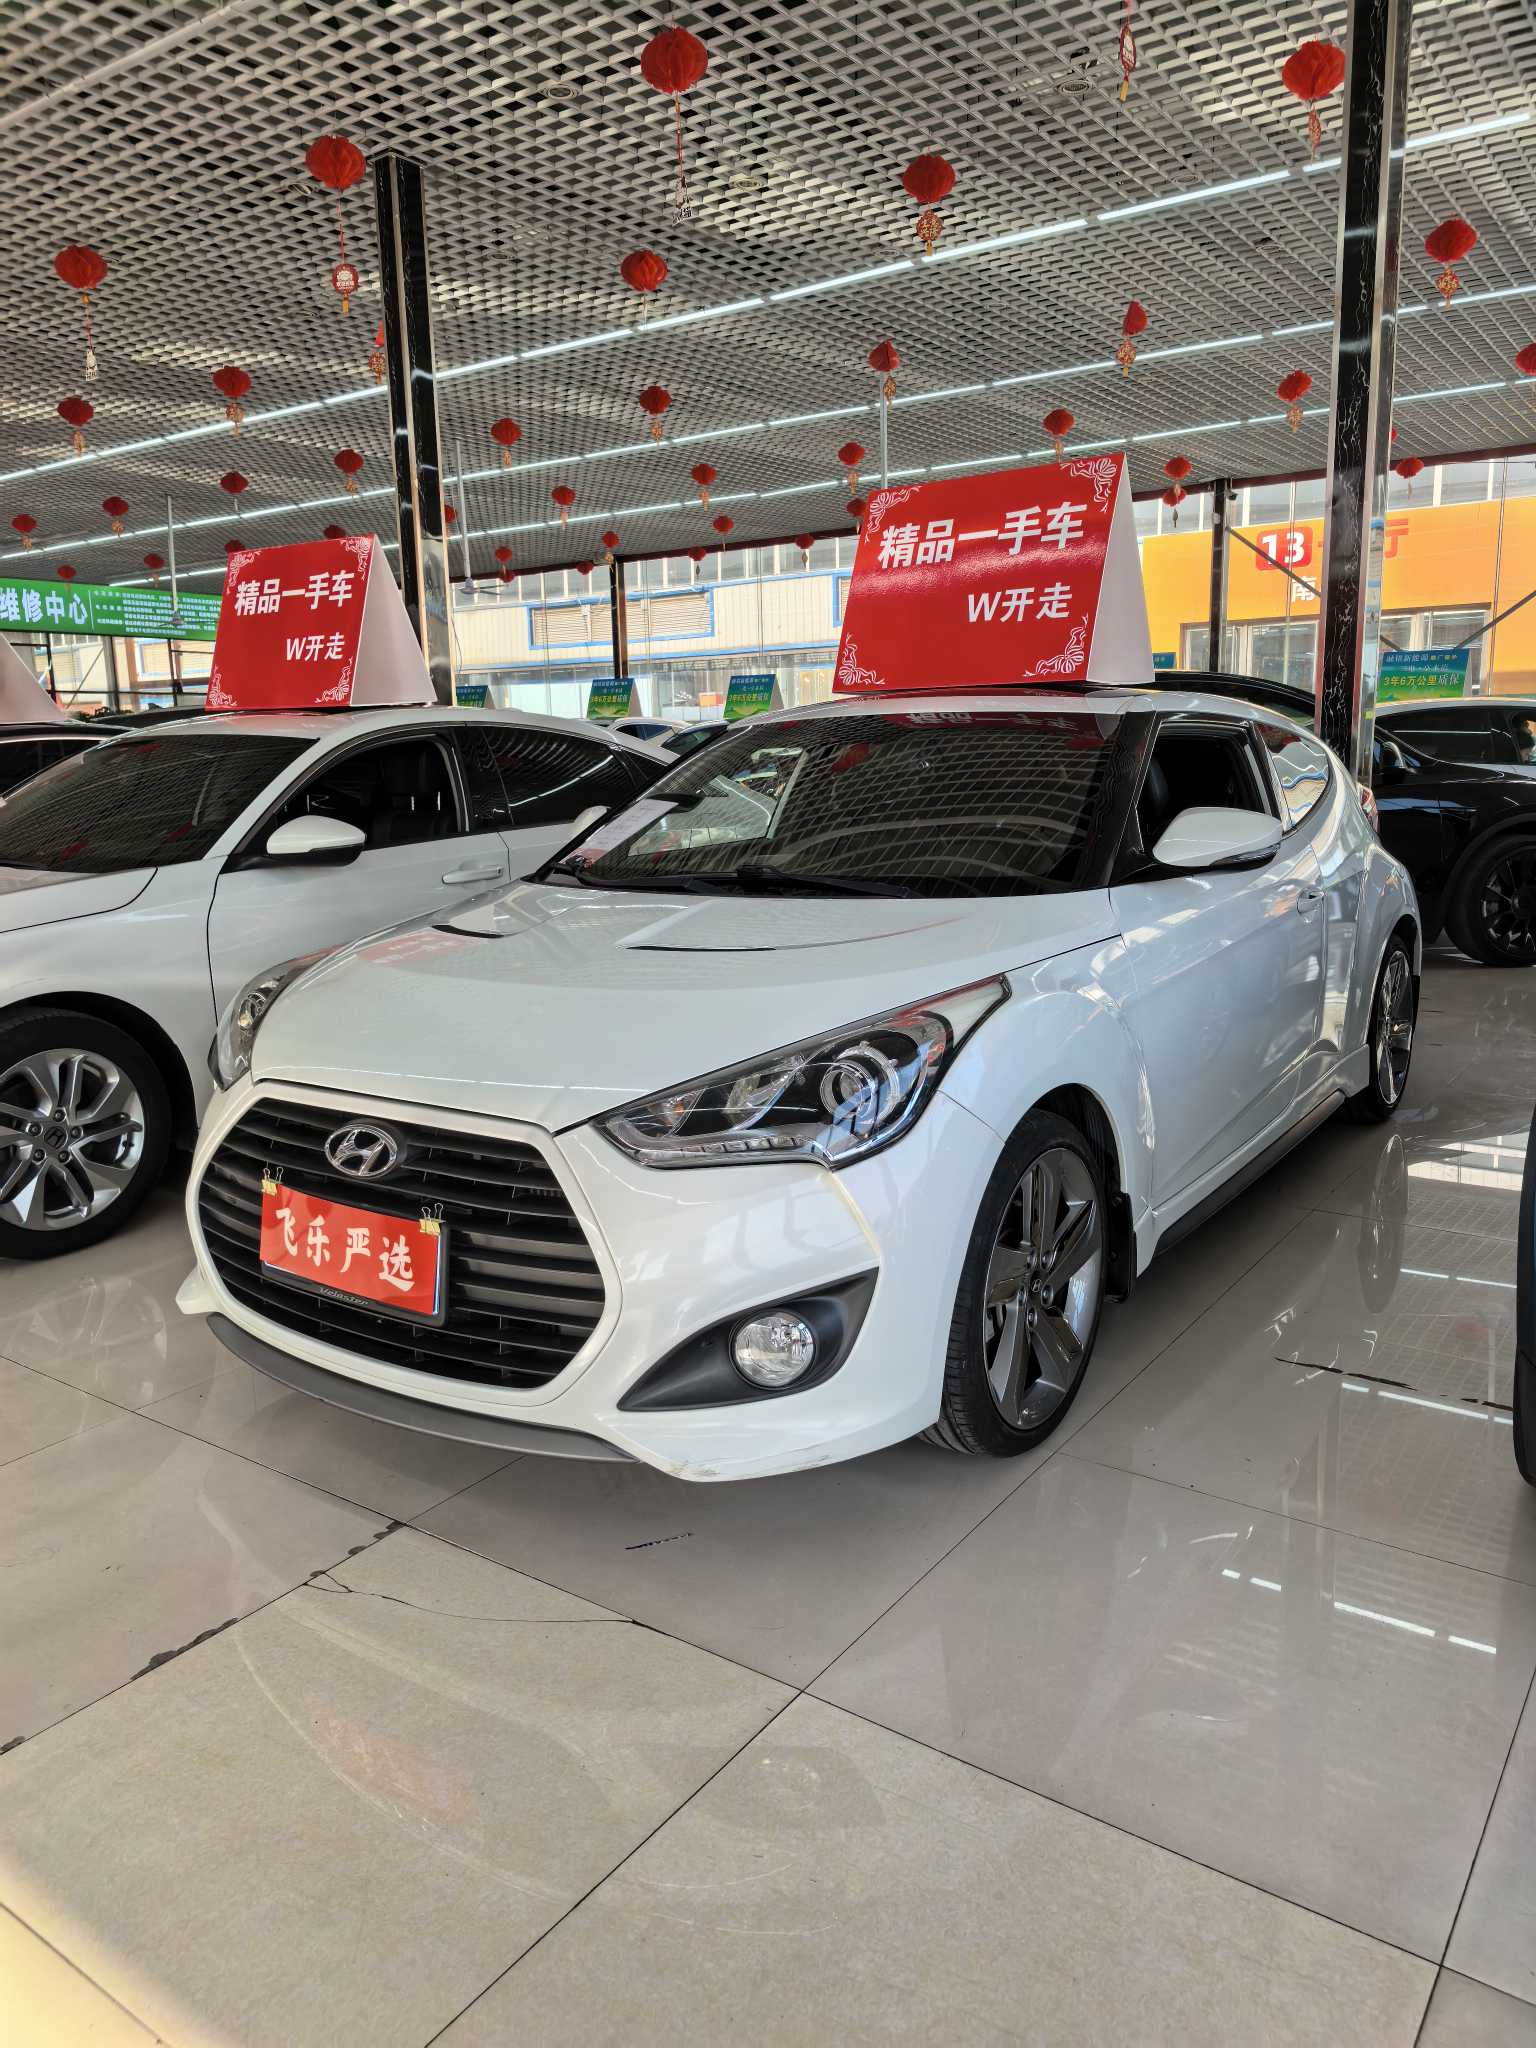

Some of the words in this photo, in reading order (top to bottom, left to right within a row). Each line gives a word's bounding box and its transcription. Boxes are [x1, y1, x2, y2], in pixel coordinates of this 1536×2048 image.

[877, 502, 1088, 569] 精品一手车
[1261, 531, 1305, 564] 13
[0, 587, 88, 625] 维修中心
[235, 570, 355, 616] 精品一手车
[967, 582, 1073, 623] W开走
[286, 632, 345, 661] W开走
[275, 1207, 415, 1292] 飞乐严选
